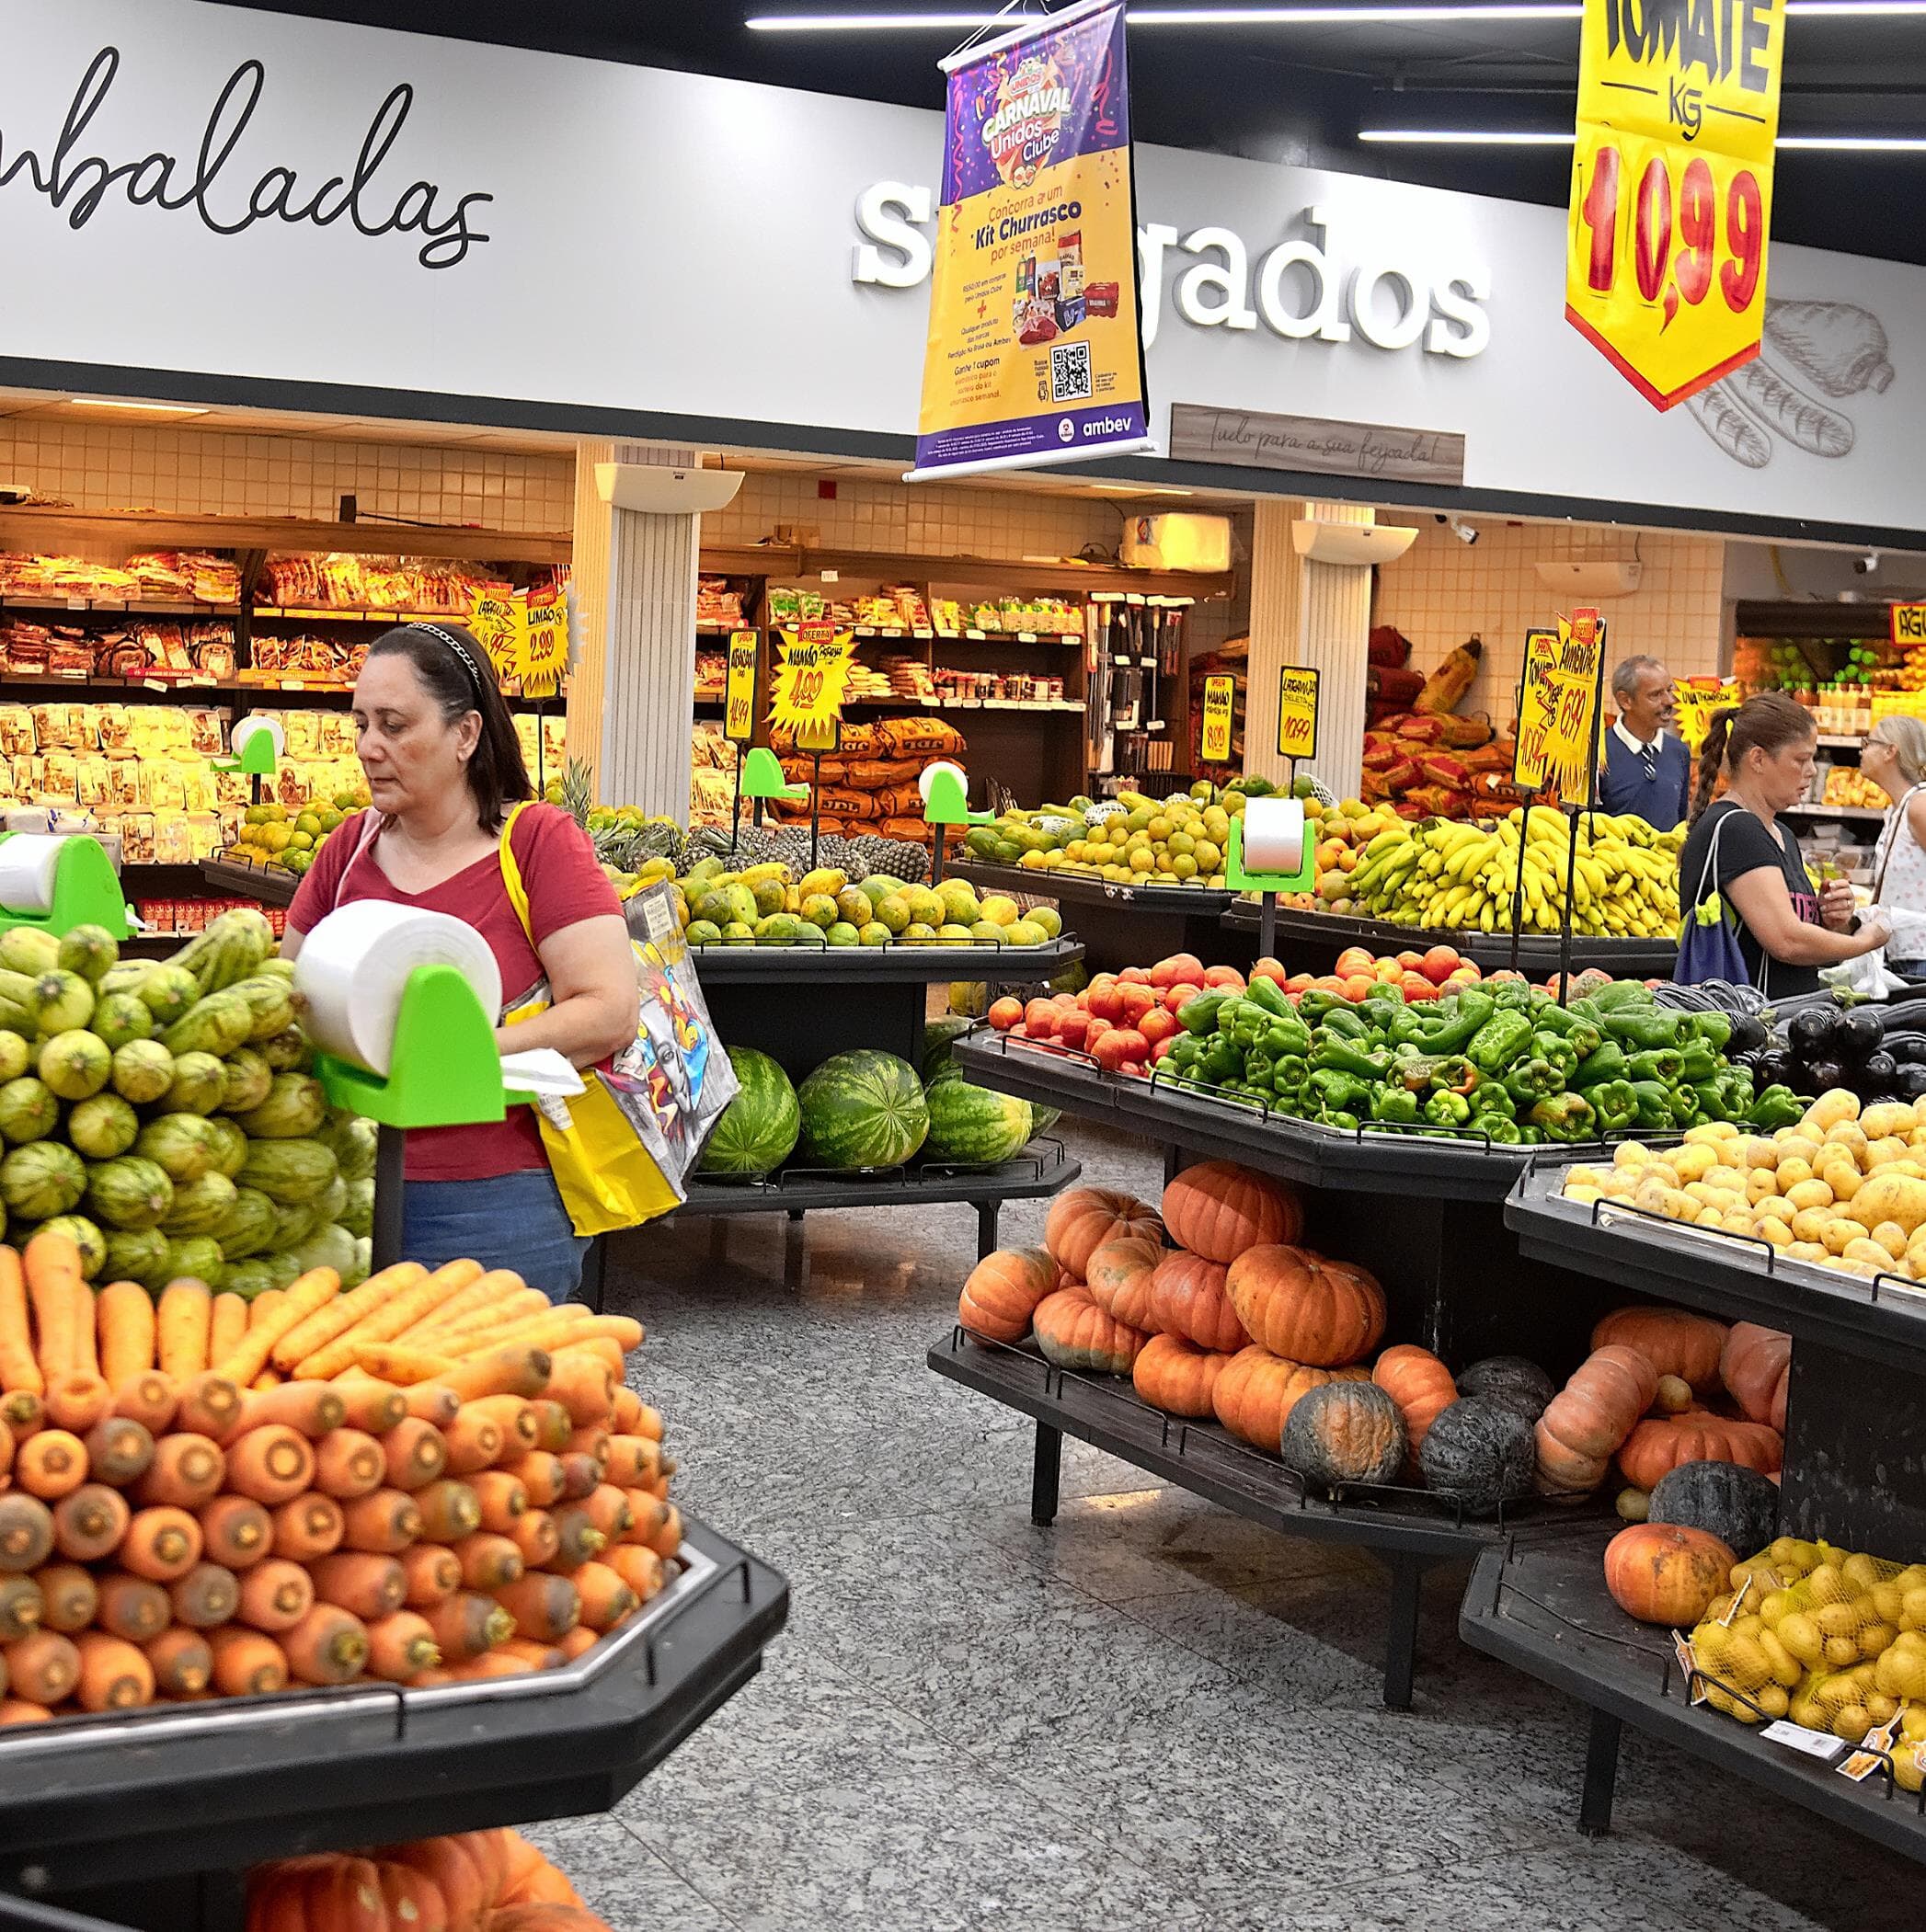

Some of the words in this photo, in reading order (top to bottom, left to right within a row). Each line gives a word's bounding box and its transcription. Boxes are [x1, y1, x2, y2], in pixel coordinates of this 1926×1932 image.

[982, 87, 1072, 143] CARNAVAL
[1668, 75, 1703, 142] KG
[991, 120, 1043, 160] Unidos
[1023, 129, 1060, 161] Clube
[988, 196, 1035, 223] Concorra
[1047, 185, 1063, 202] um
[976, 224, 995, 250] Kit
[999, 201, 1082, 241] Churrasco
[1582, 146, 1762, 337] 10,99
[991, 246, 1008, 265] por
[1010, 226, 1056, 255] semana!
[993, 337, 1012, 347] Ambev
[954, 362, 972, 376] Ganhe
[976, 357, 1000, 371] cupom
[1083, 416, 1133, 437] ambev
[1204, 411, 1254, 452] Tudo
[1255, 430, 1303, 460] para
[1322, 436, 1356, 456] sua
[802, 629, 831, 641] OFERTA
